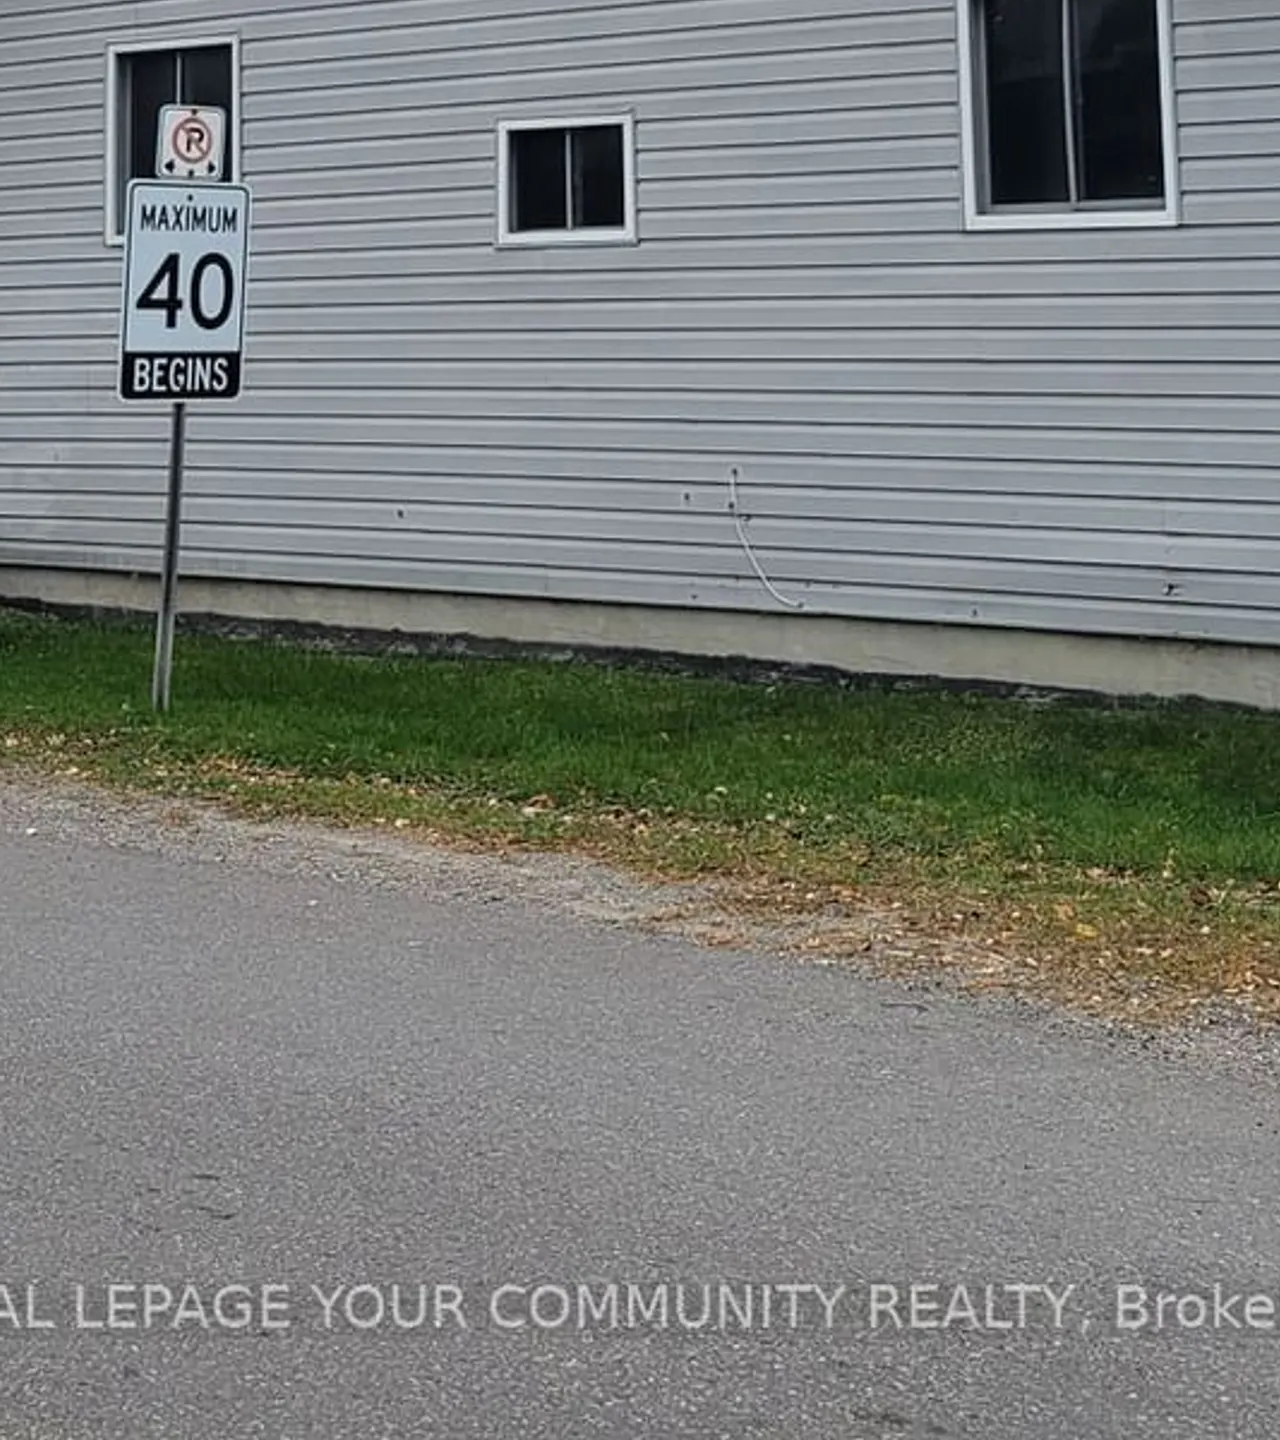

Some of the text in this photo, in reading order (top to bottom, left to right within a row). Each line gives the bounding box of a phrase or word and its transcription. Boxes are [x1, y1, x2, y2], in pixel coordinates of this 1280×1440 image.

[140, 204, 238, 233] MAXIMUM
[136, 252, 234, 331] 40
[133, 357, 228, 393] BEGINS
